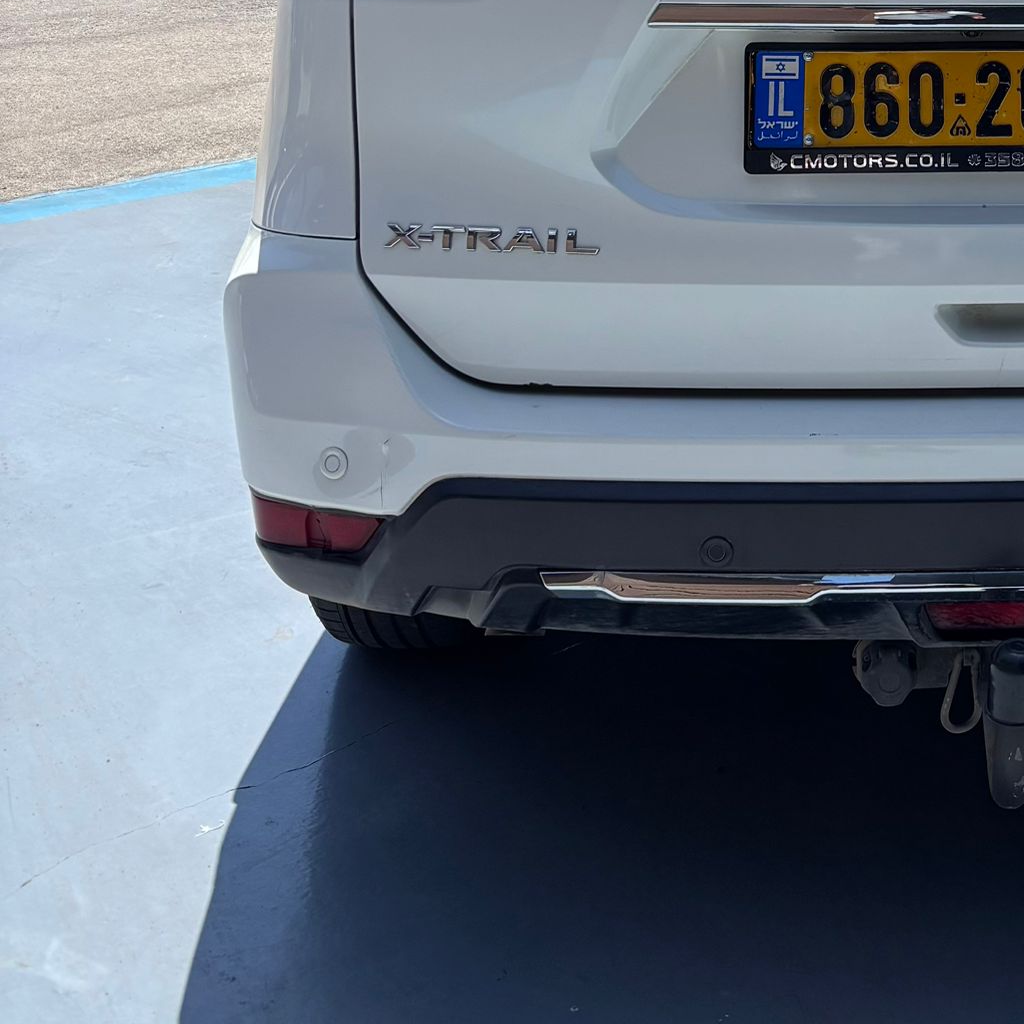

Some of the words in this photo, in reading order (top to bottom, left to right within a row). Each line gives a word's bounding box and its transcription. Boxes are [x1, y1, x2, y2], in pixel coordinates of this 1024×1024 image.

[767, 81, 795, 117] IL
[757, 118, 799, 130] ישראל
[790, 152, 959, 169] CMOTORS.CO.IL
[384, 223, 600, 256] X-TRAIL
